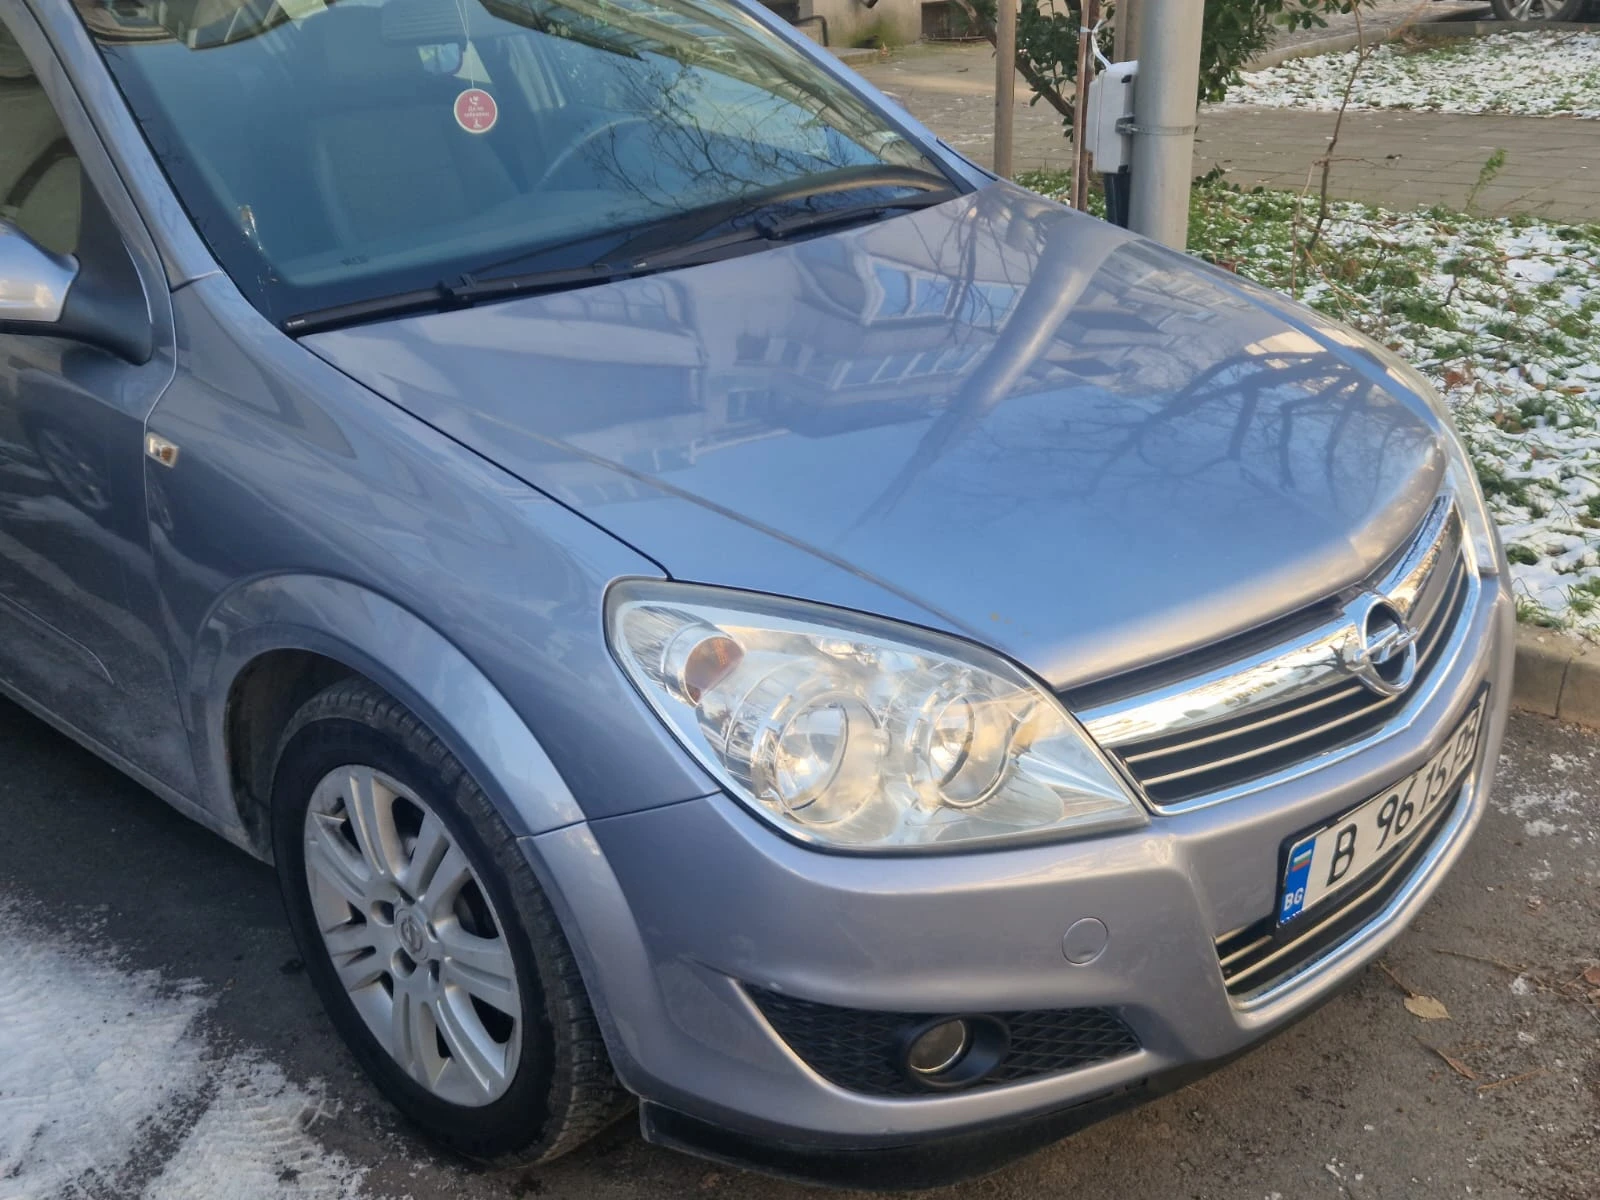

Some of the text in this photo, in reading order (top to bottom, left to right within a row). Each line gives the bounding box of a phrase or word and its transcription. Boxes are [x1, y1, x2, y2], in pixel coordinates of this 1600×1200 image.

[1326, 822, 1358, 888] B
[1375, 743, 1453, 852] 9615
[1284, 887, 1304, 911] BG
